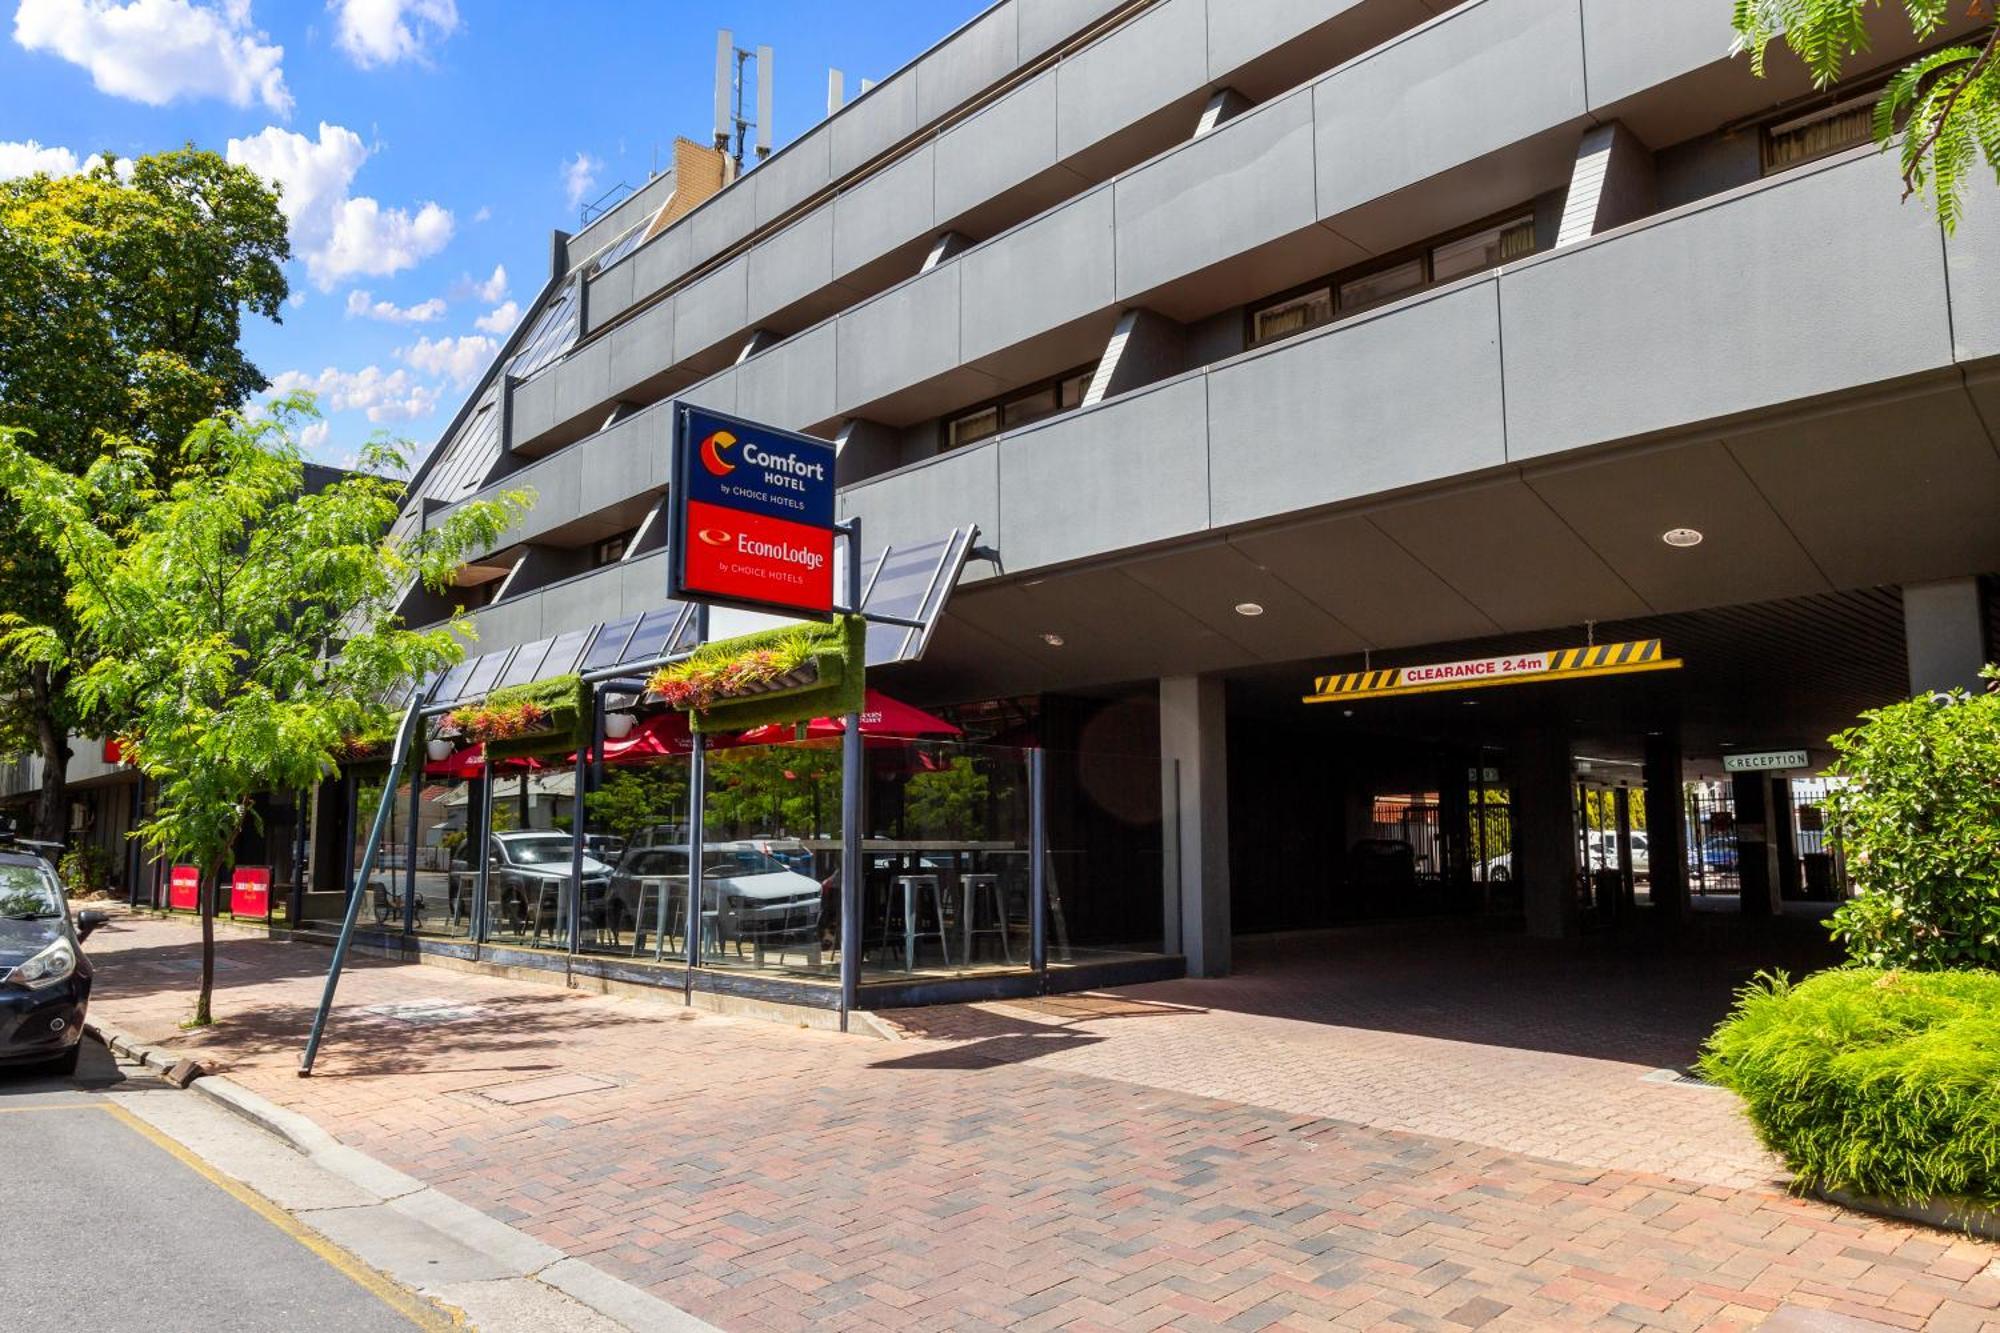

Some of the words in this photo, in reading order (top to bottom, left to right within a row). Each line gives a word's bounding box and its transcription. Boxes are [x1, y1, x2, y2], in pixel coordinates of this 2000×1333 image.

[743, 443, 824, 480] Comfort
[764, 471, 805, 491] HOTEL
[720, 483, 731, 494] by
[732, 486, 768, 502] CHOICE
[770, 495, 805, 510] HOTELS
[738, 533, 823, 570] EconoLodge
[719, 561, 729, 573] by
[731, 563, 766, 578] CHOICE
[768, 570, 804, 585] HOTELS
[1407, 662, 1495, 681] CLEARANCE
[1502, 658, 1542, 672] 2.4m
[1737, 754, 1805, 768] RECEPTION
